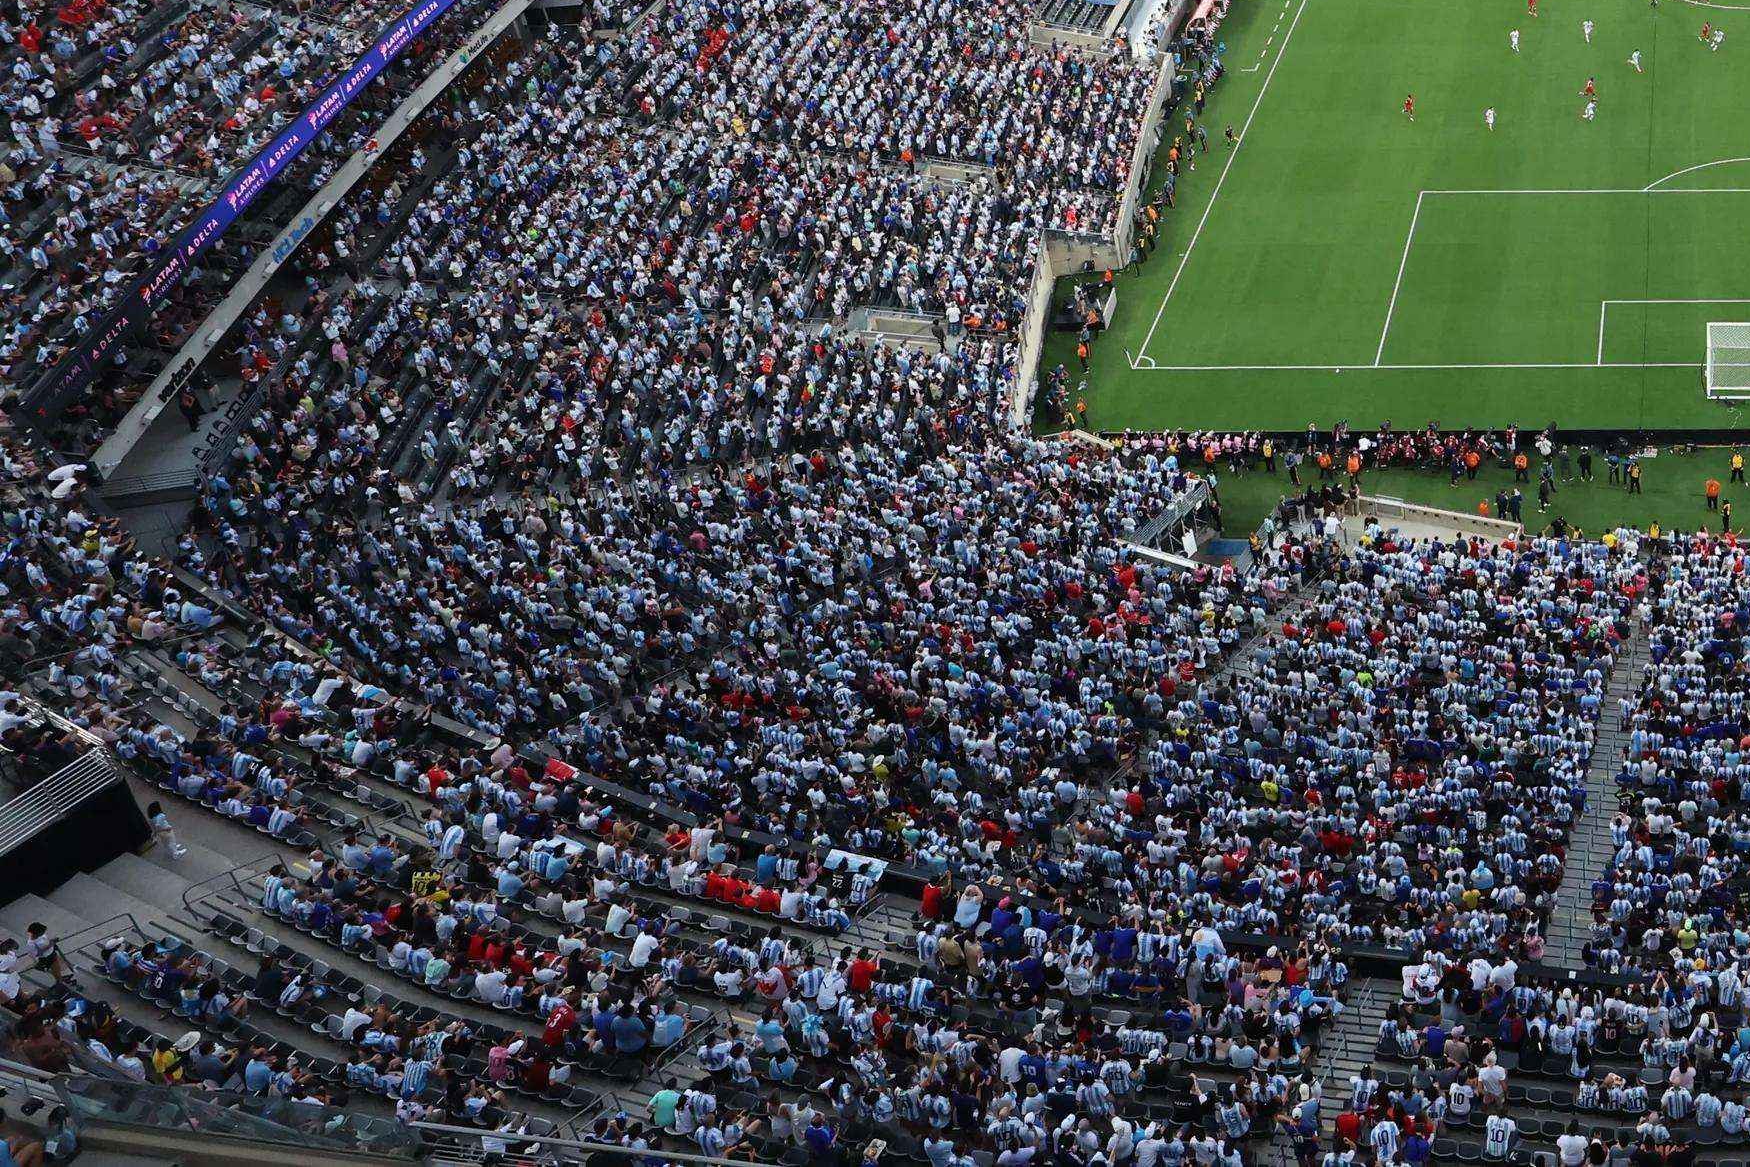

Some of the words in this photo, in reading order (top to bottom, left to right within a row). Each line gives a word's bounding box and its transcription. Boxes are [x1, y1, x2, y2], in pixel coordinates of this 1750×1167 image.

[418, 1, 439, 21] DELTA
[385, 25, 408, 49] LATAM
[468, 35, 491, 56] MetLife
[351, 63, 372, 86] DELTA
[316, 91, 341, 118] LATAM
[275, 134, 300, 162] DELTA
[235, 167, 262, 198] LATAM
[194, 218, 219, 248] DELTA
[150, 257, 179, 290] LATAM
[100, 316, 130, 353] DELTA
[1027, 935, 1037, 948] 10
[1605, 1027, 1616, 1040] 10
[1453, 1092, 1464, 1106] 10
[1378, 1130, 1389, 1145] 10
[1490, 1128, 1504, 1144] 10
